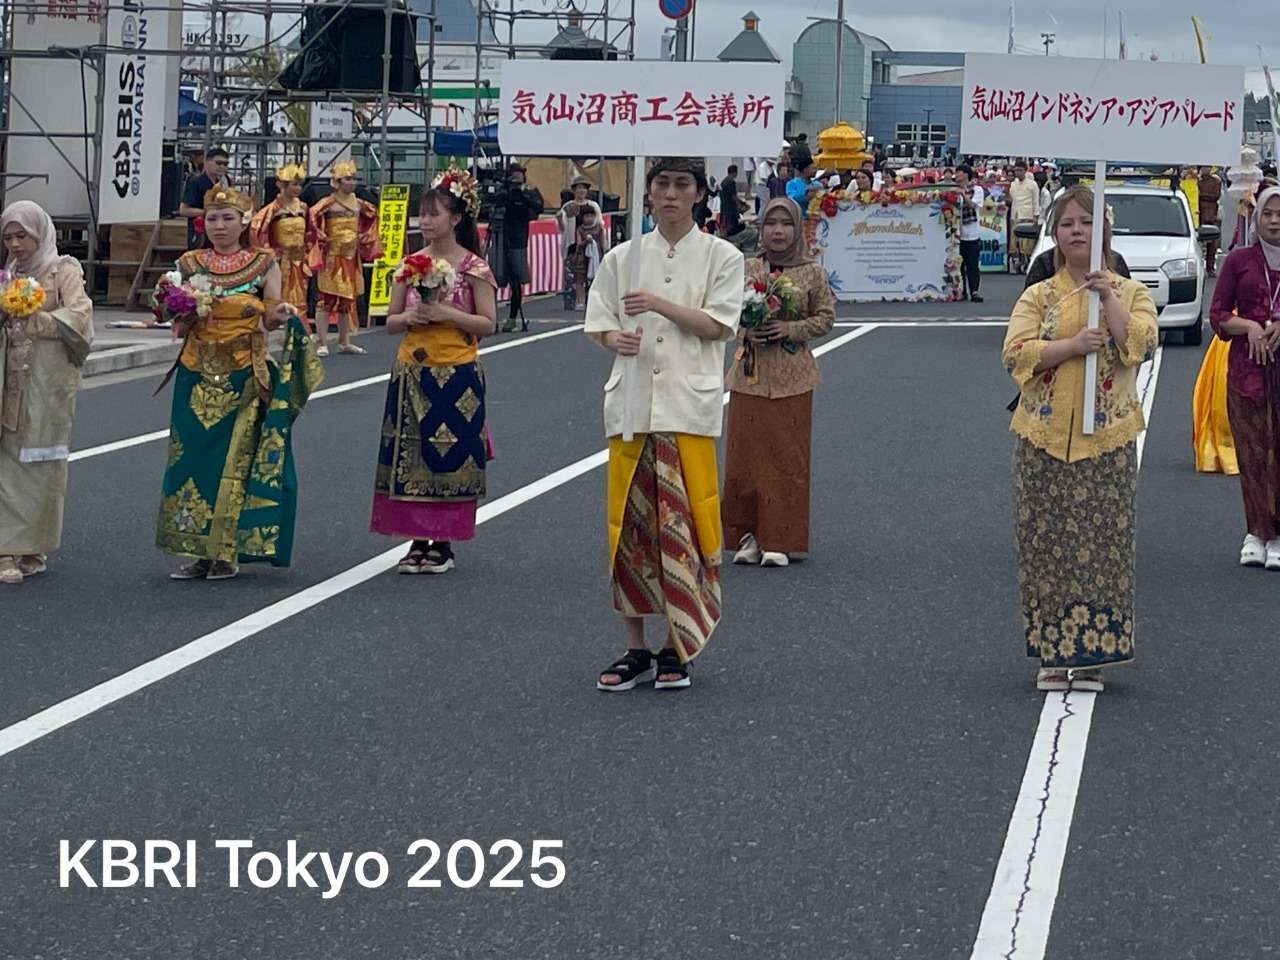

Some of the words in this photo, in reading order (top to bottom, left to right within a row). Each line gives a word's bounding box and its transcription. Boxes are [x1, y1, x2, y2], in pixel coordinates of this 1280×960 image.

[510, 90, 774, 129] 気仙沼商工会議所
[970, 85, 1236, 132] 気仙沼インドネシア・アジアパレード
